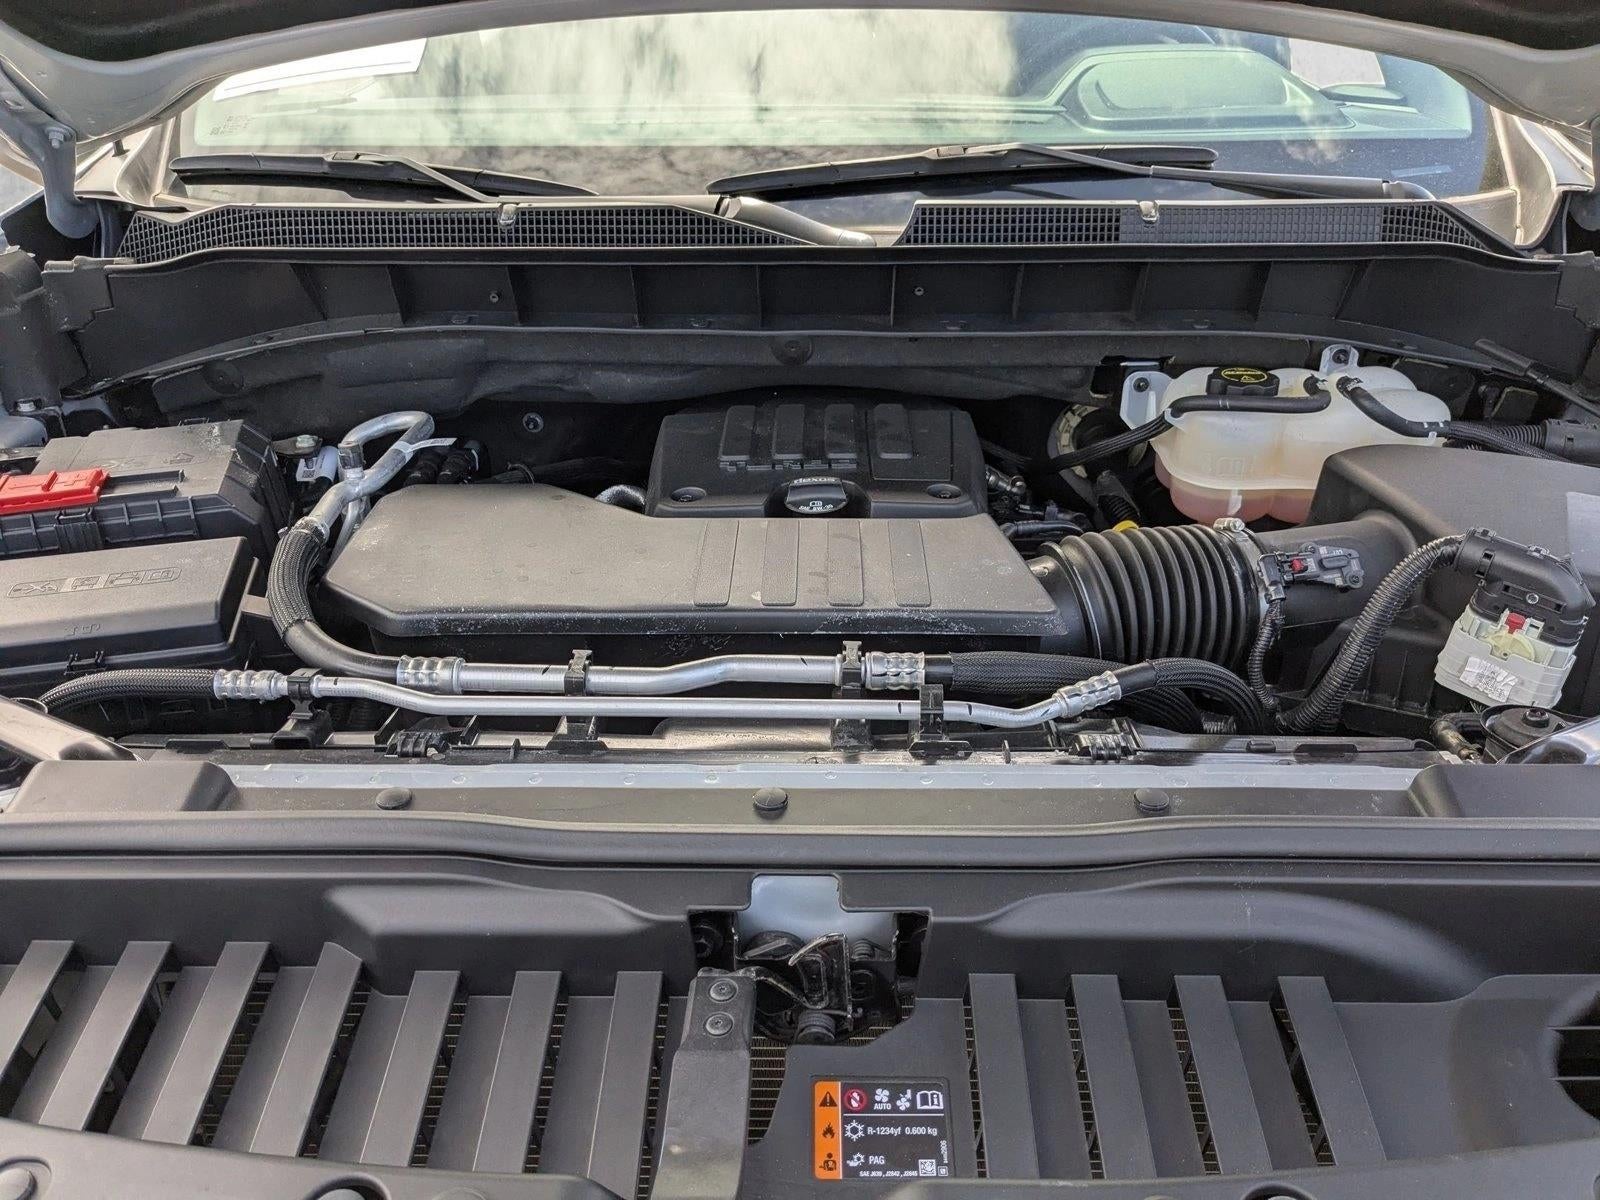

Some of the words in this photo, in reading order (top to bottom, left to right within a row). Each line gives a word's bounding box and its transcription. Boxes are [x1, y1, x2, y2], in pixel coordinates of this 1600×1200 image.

[867, 1127, 901, 1136] R-1234yf
[927, 1127, 938, 1136] kg
[869, 1156, 885, 1164] PAG
